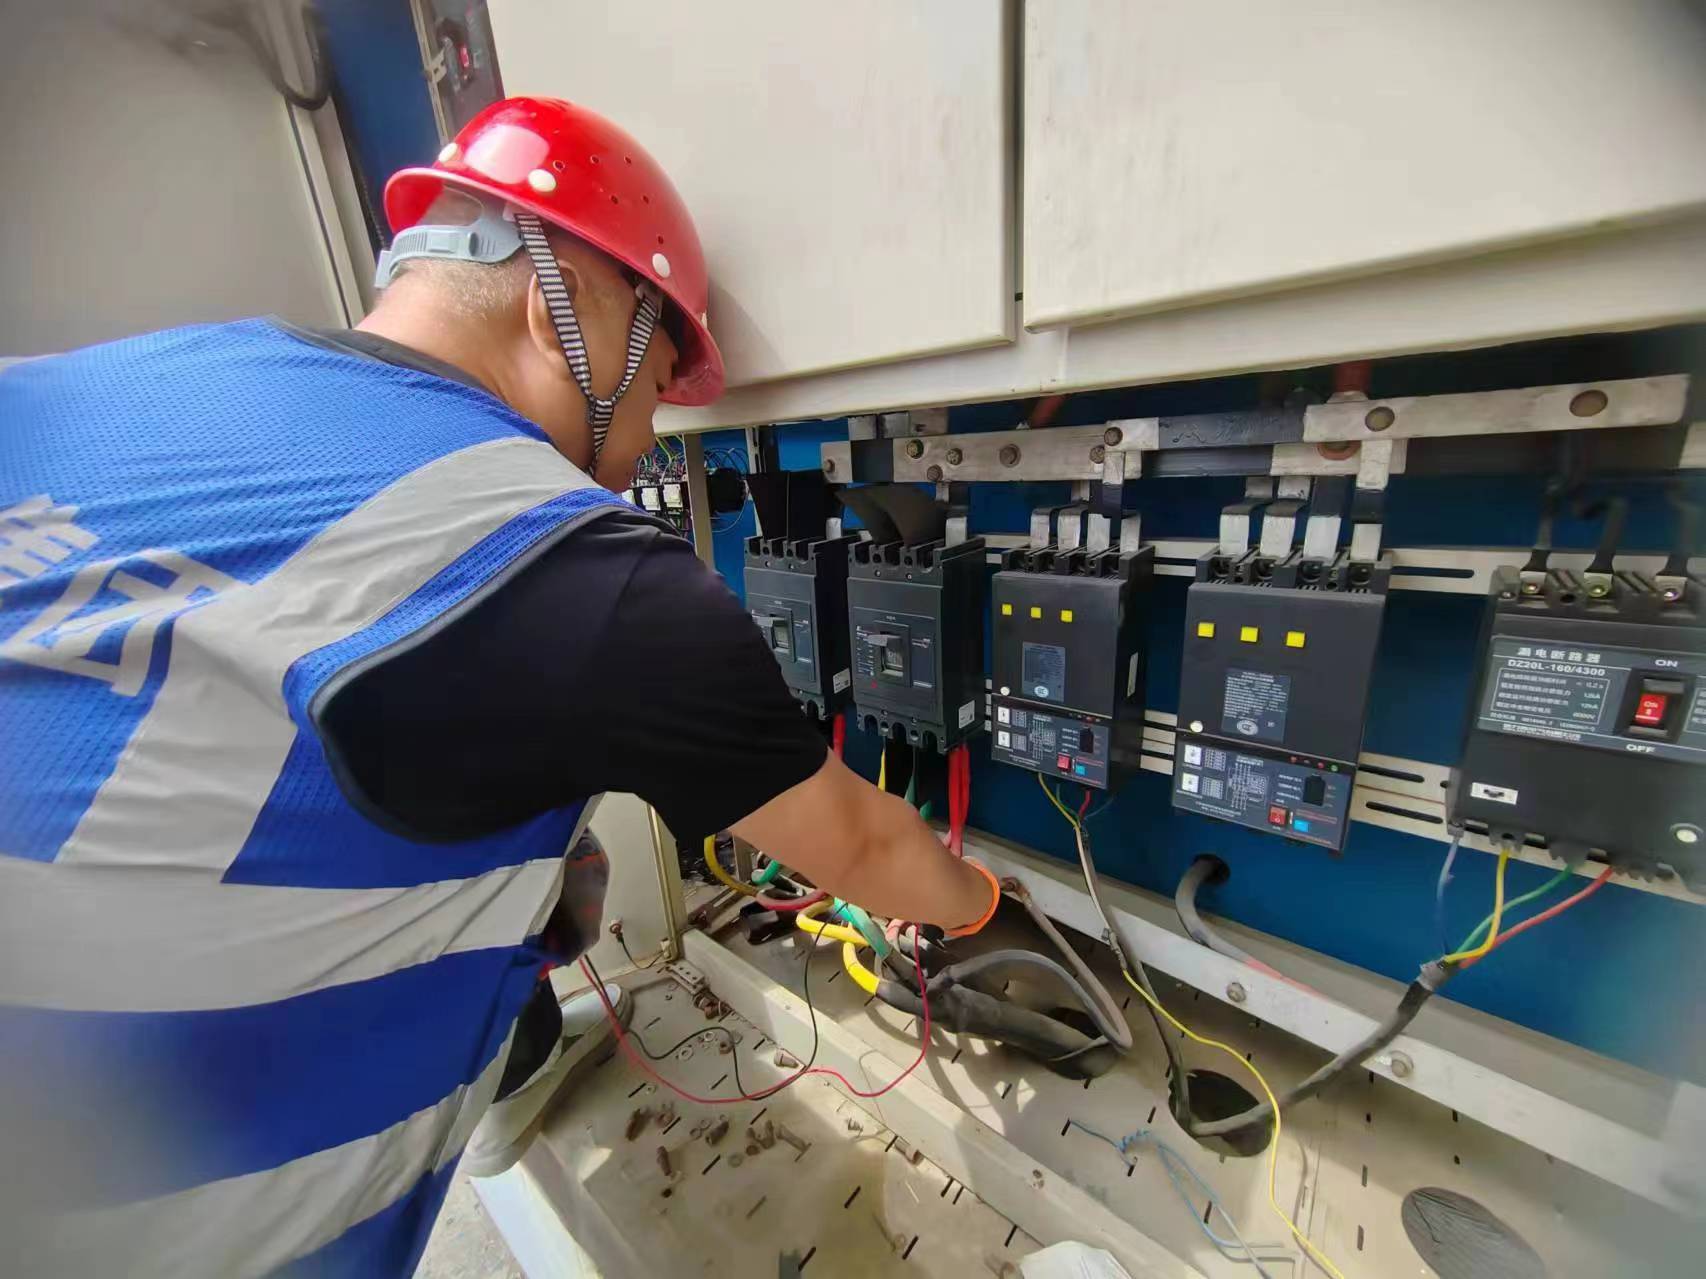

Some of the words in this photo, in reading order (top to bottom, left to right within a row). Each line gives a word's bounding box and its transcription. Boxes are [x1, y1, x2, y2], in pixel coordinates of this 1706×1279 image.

[1507, 659, 1606, 677] DZ20L-160/4300
[1655, 659, 1679, 668] ON
[1626, 743, 1656, 753] OFF
